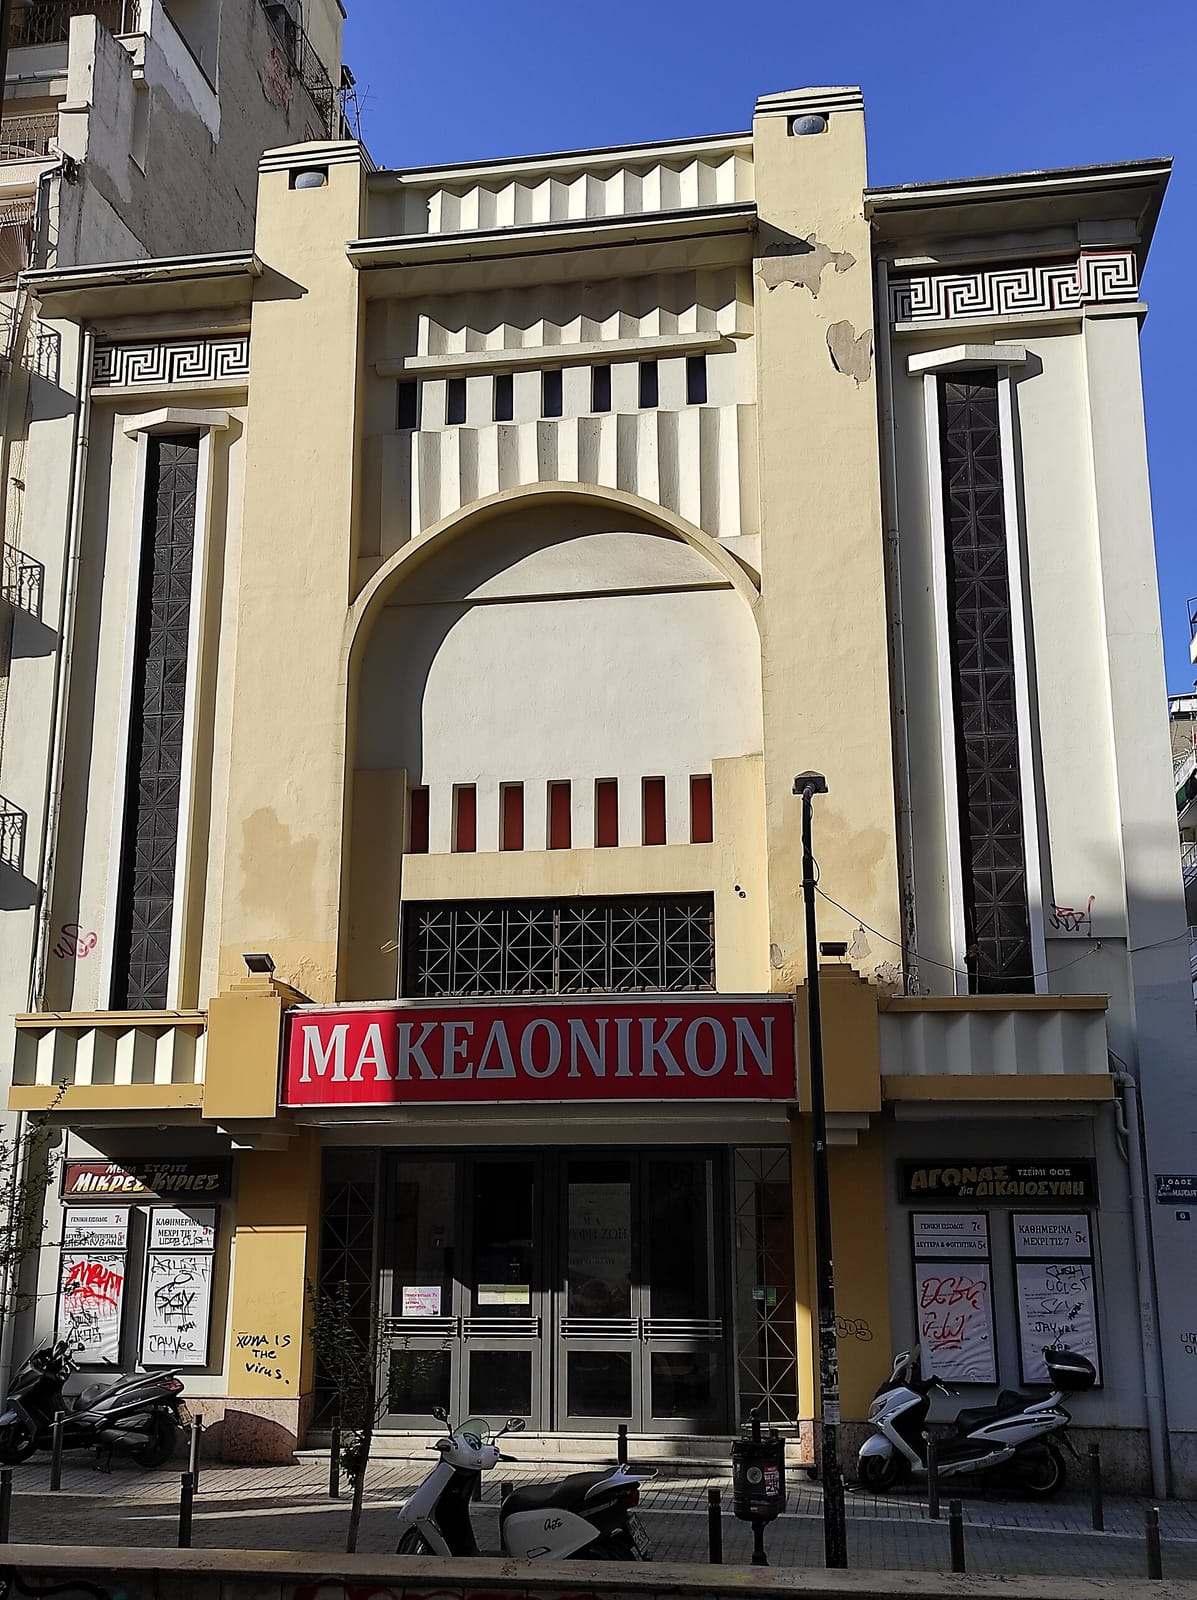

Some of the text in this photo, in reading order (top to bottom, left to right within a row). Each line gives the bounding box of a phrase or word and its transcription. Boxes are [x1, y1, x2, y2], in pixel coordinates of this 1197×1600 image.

[300, 1015, 776, 1083] ΜΑΚΕΔΟΝΙΚΟΝ
[72, 1171, 220, 1192] ΜΙΚΡΕΣ ΚΥΡΙΕΣ
[910, 1165, 1009, 1192] ΑΓΩΝΑΣ
[975, 1180, 1084, 1196] ΔΙΚΑΙΟΣΥΝΗ
[155, 1218, 200, 1227] ΚΑΘΗΜΕΡΙΝΑ
[1018, 1225, 1073, 1234] ΚΑΘΗΜΕΡΙΝΑ
[1023, 1237, 1070, 1246] ΜΕΧΡΙ ΤΙΣ 7
[1075, 1231, 1087, 1243] 5€
